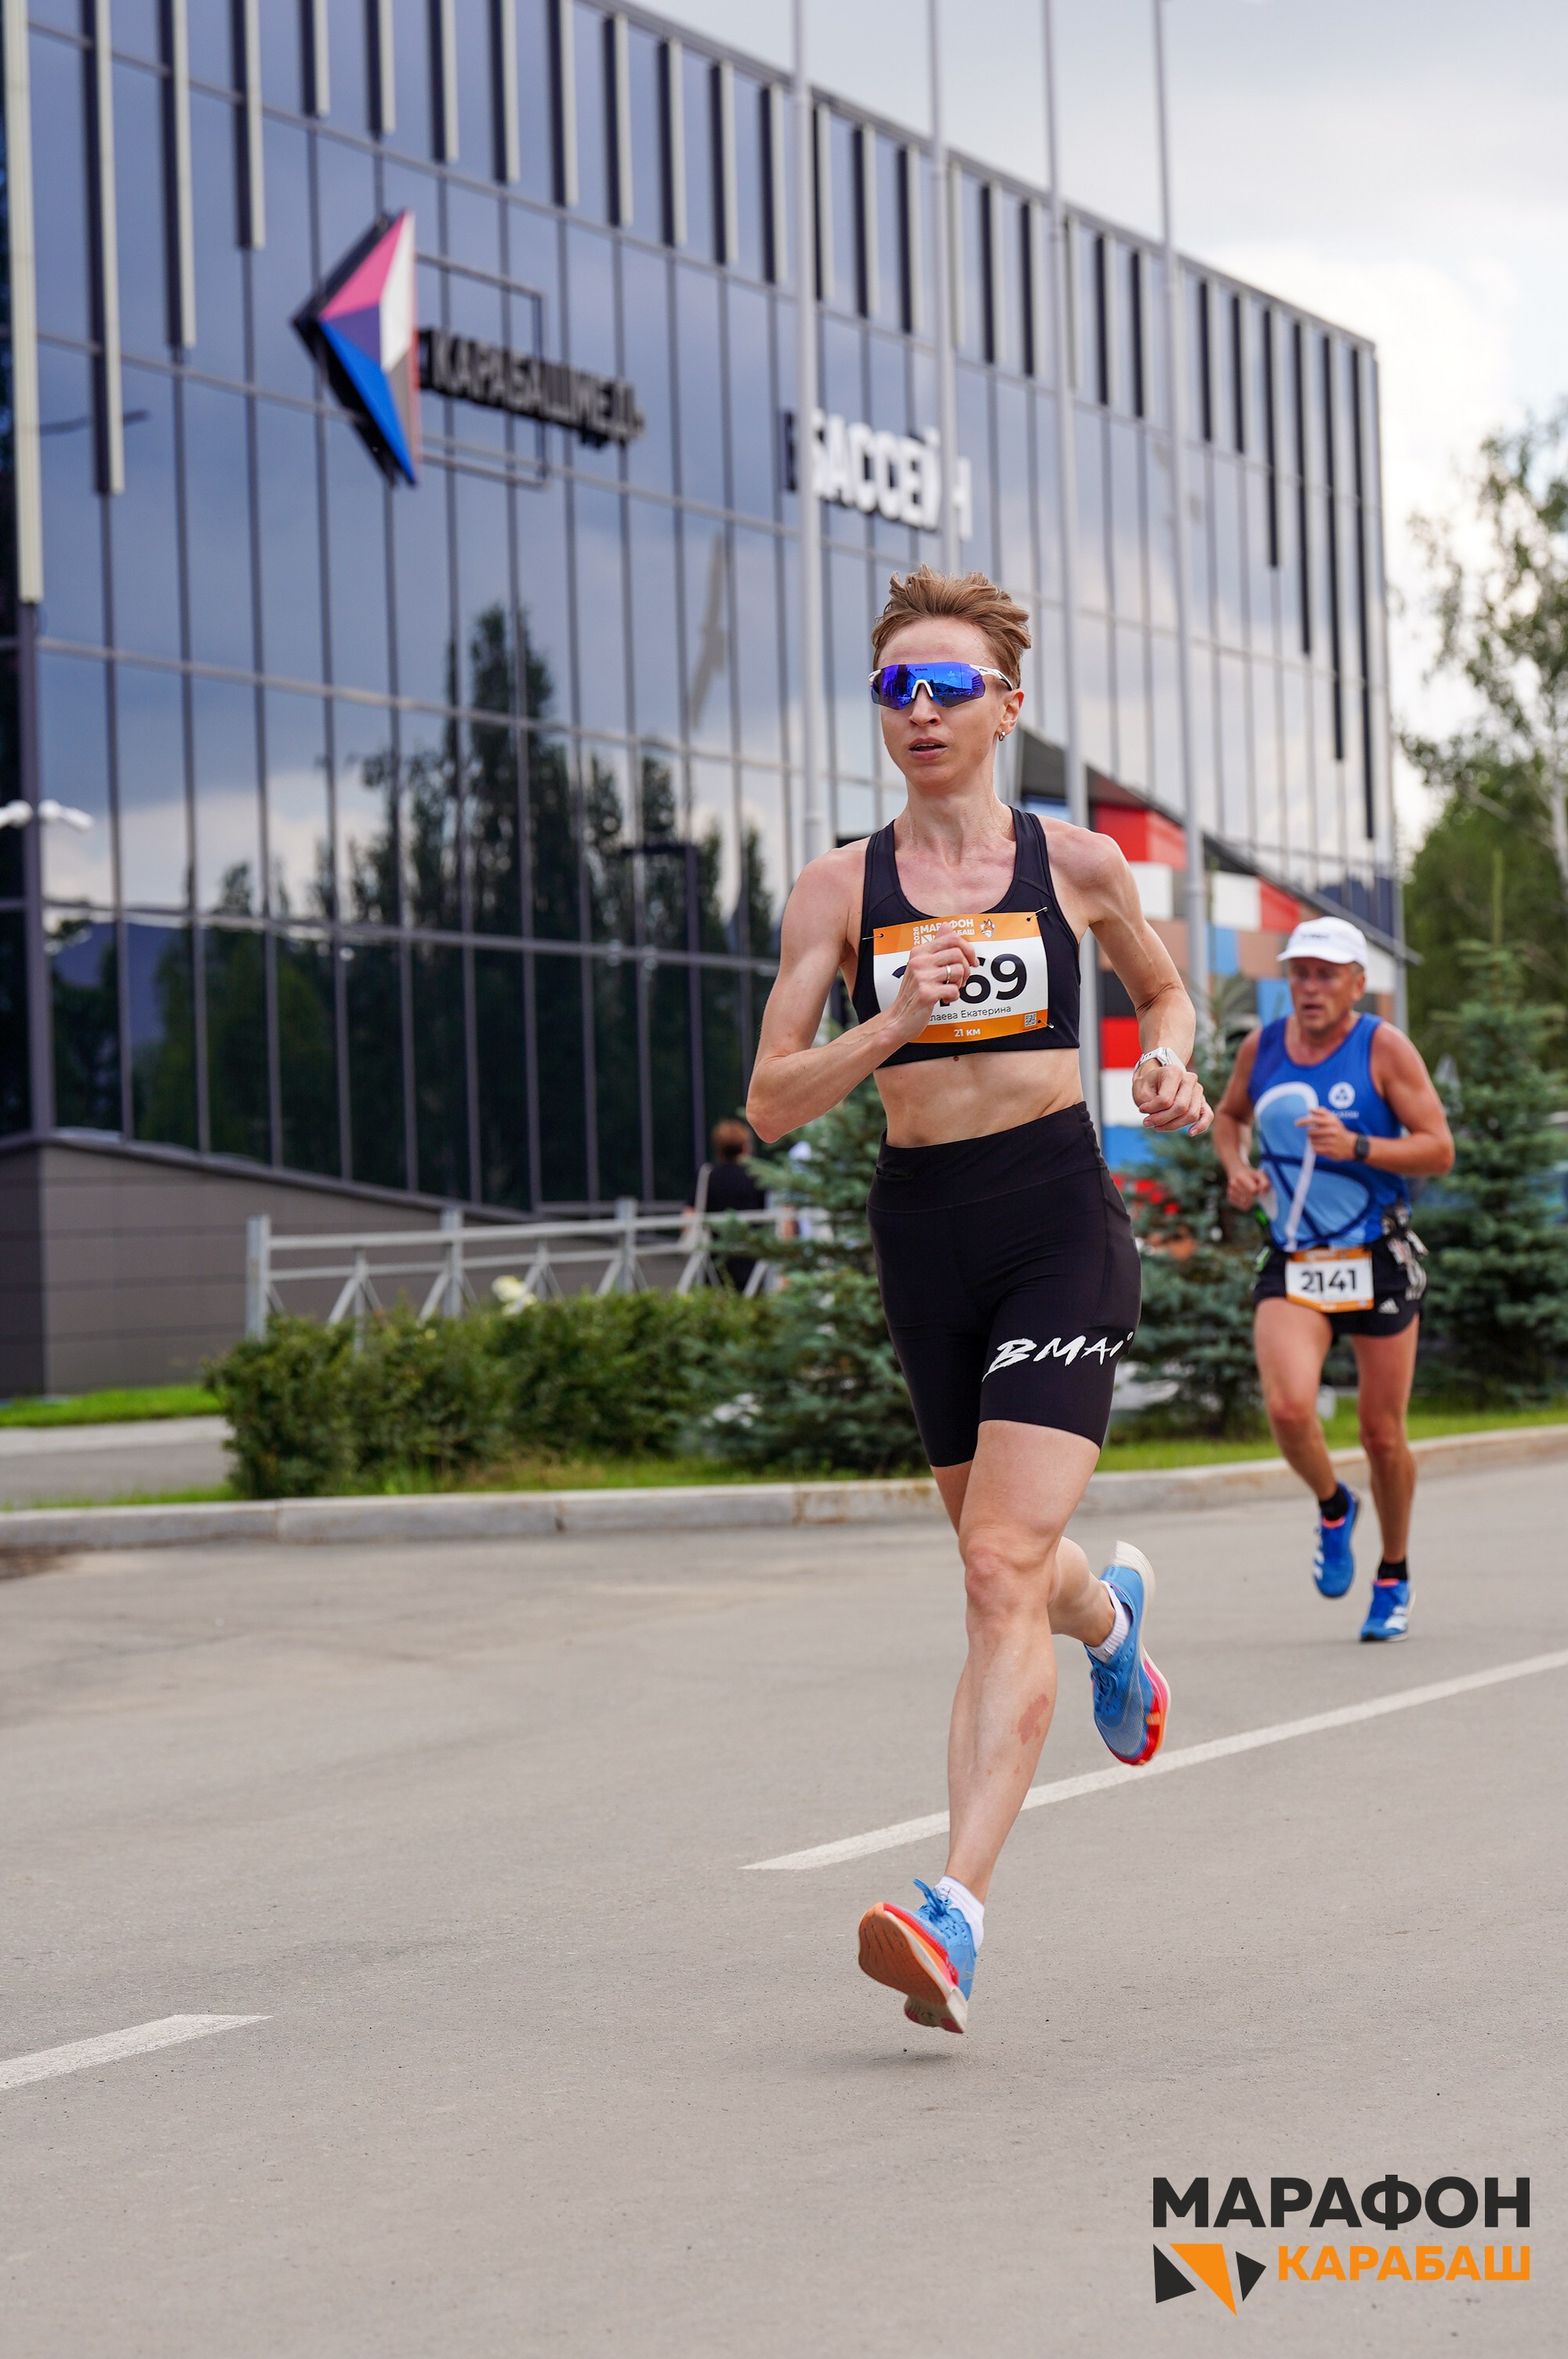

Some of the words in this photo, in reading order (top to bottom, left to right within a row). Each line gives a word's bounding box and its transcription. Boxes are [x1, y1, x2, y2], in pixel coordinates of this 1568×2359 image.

[920, 918, 975, 934] МАРФОН
[891, 953, 1028, 1008] 69
[960, 1006, 1011, 1019] Екатерина
[953, 1028, 964, 1038] 21
[1301, 1268, 1357, 1295] 2141
